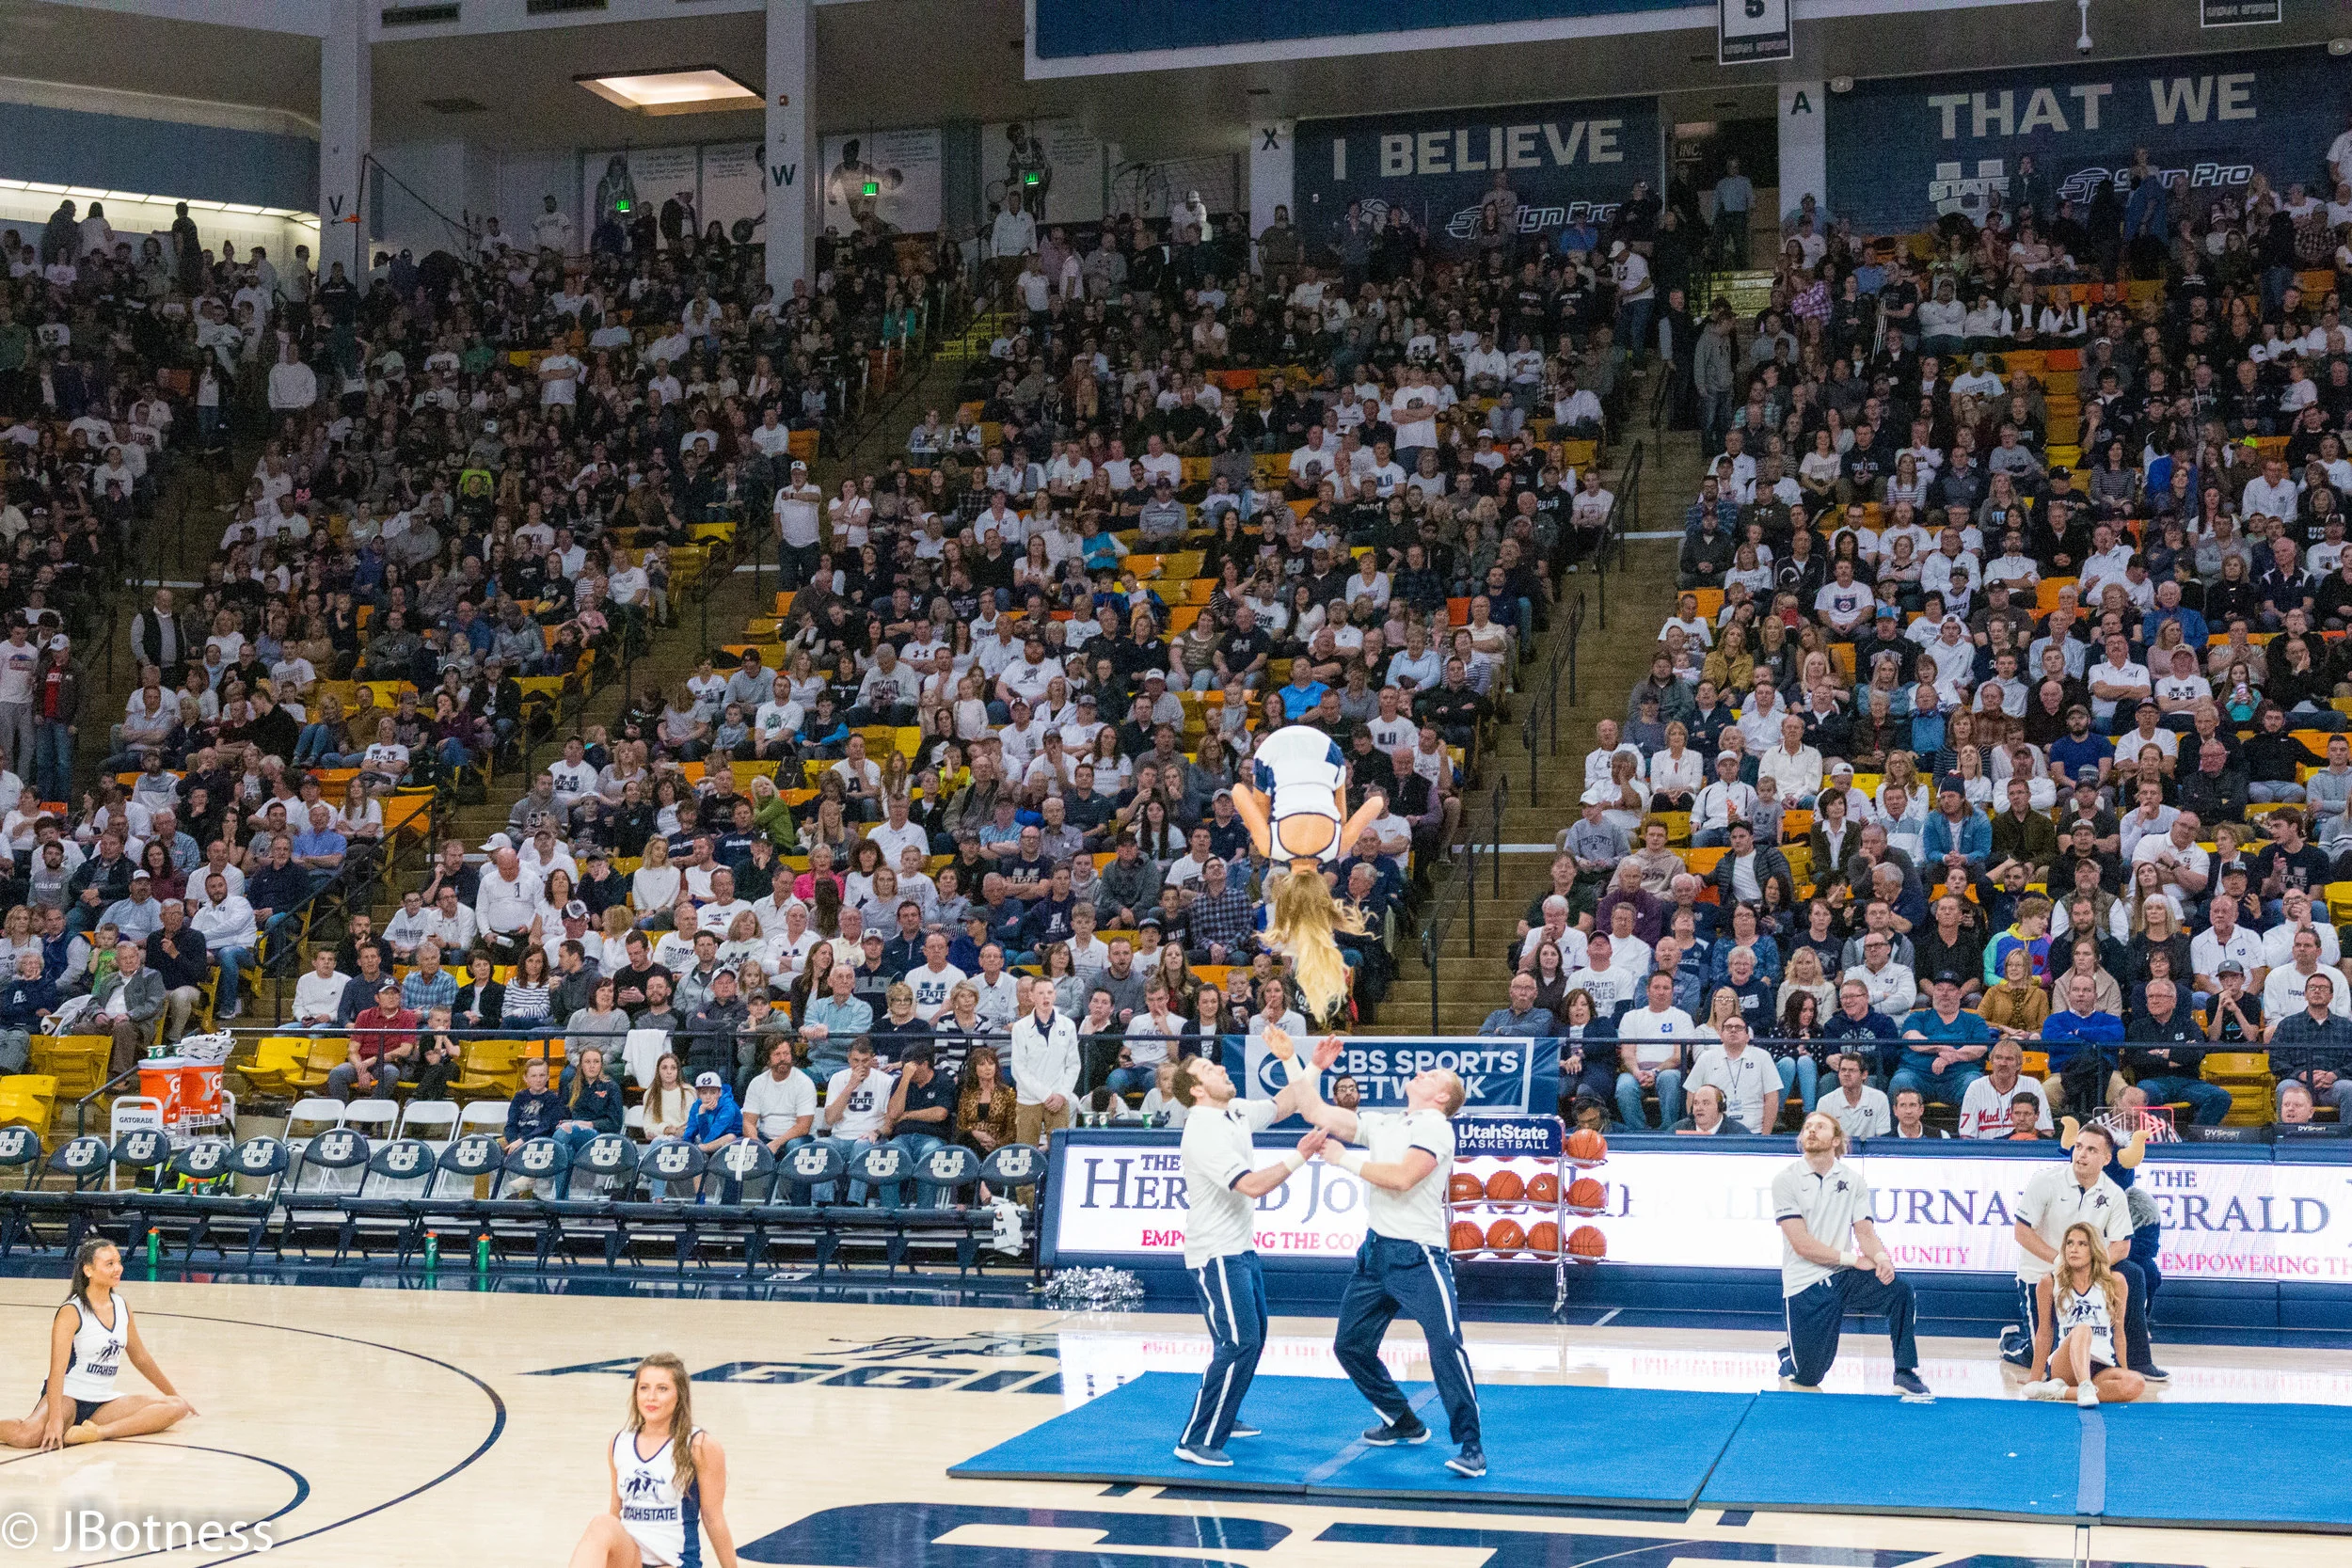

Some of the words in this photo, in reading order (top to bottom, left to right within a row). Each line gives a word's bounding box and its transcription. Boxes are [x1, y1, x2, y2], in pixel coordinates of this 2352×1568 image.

[1791, 91, 1812, 115] A
[1928, 83, 2112, 140] THAT
[2150, 72, 2256, 125] WE
[1262, 128, 1280, 151] X
[1333, 138, 1346, 181] I
[1380, 119, 1623, 178] BELIEVE
[771, 164, 798, 187] W
[2191, 163, 2254, 187] Pro
[329, 195, 344, 217] V
[2280, 876, 2307, 886] TATE
[916, 990, 946, 999] STATE
[1327, 1050, 1388, 1074] CBS
[1395, 1050, 1519, 1074] SPORTS
[1960, 1114, 1970, 1128] 7
[1979, 1108, 2000, 1124] Mud
[1459, 1124, 1549, 1140] UtahState
[1459, 1139, 1549, 1149] BASKETBALL
[1140, 1154, 1181, 1171] THE
[2149, 1169, 2198, 1187] THE
[2161, 1193, 2331, 1235] ERALD
[1279, 1231, 1320, 1249] THE
[2161, 1252, 2319, 1275] EMPOWERING
[2324, 1258, 2352, 1276] TH
[644, 1507, 678, 1522] STATE
